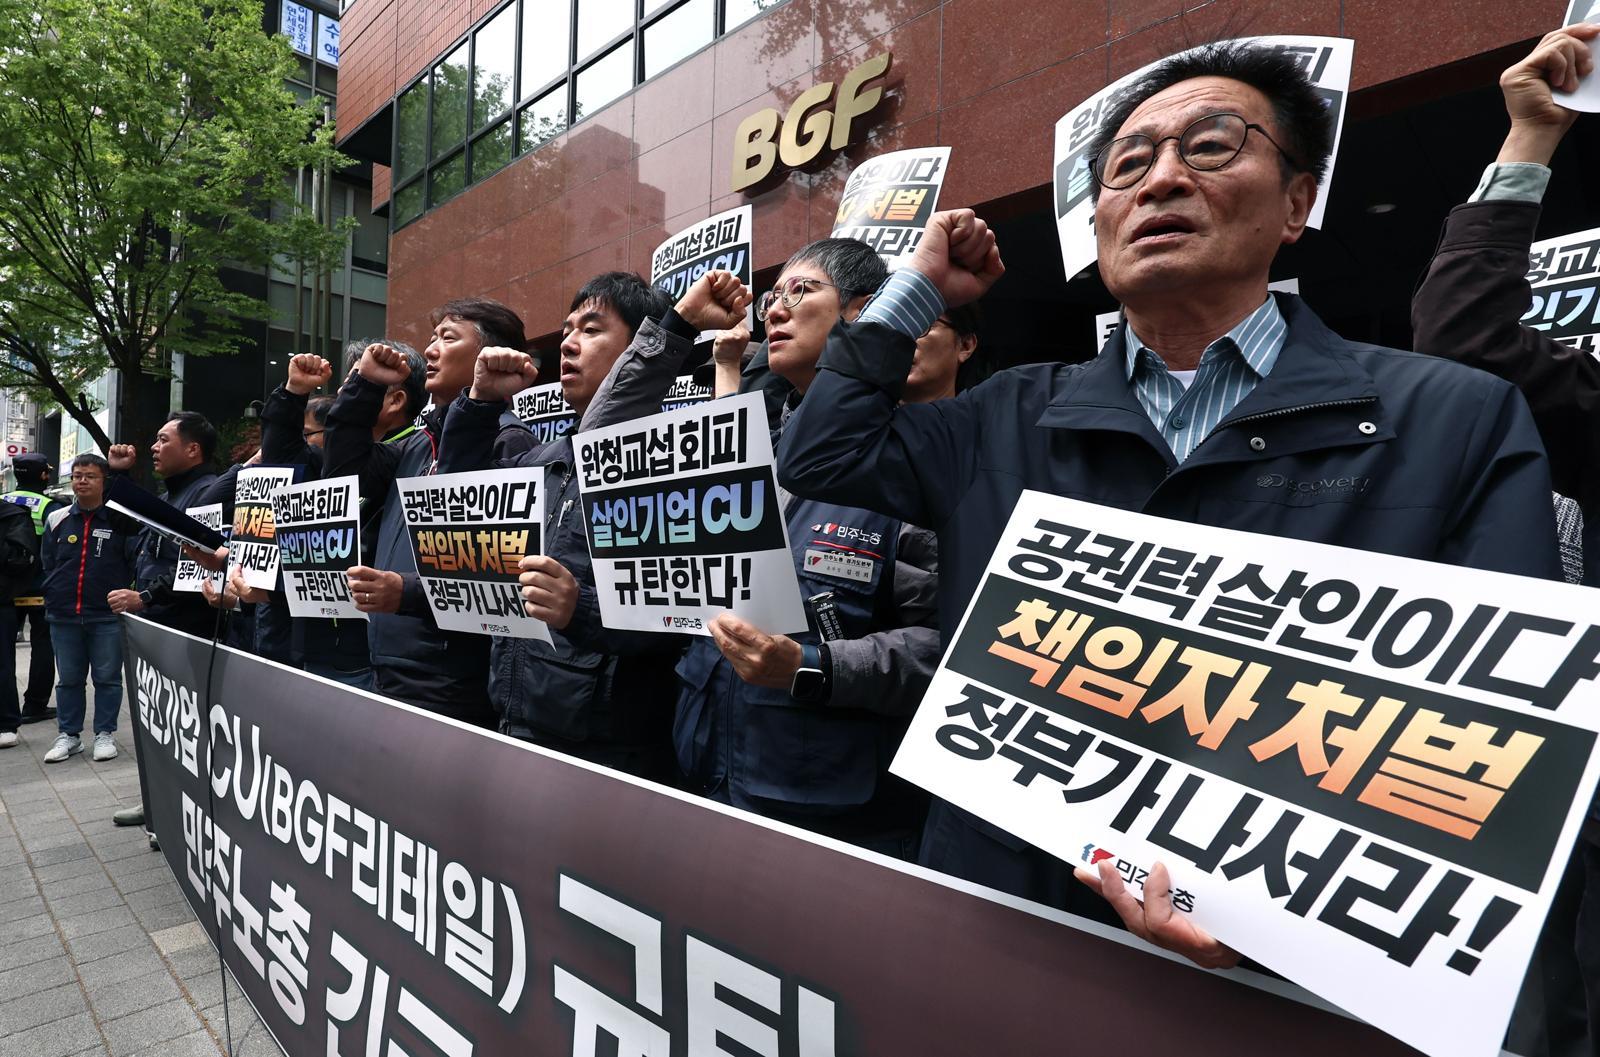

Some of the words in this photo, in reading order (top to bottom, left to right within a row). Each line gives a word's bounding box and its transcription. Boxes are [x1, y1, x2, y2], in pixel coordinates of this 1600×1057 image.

[324, 23, 339, 62] 수액
[731, 52, 893, 192] BGF
[703, 214, 743, 253] 회피
[517, 388, 563, 419] 원청교섭
[581, 424, 675, 488] 원청교섭
[679, 407, 748, 472] 회피
[316, 485, 350, 519] 회피
[403, 487, 447, 522] 공권력
[447, 481, 537, 521] 살인이다
[591, 488, 696, 548] 살인기업
[702, 479, 765, 534] CU
[279, 529, 324, 564] 살인기업
[326, 528, 354, 559] CU
[417, 530, 477, 573] 책임자
[477, 529, 529, 575] 처벌
[837, 526, 882, 545] 민주노총
[479, 583, 533, 618] 나서
[614, 555, 752, 609] 규탄한다!
[673, 616, 703, 629] 민주노총
[1007, 518, 1224, 620] 공권력
[1197, 562, 1600, 711] 살인이다
[136, 657, 201, 778] 살인기업
[987, 597, 1273, 752] 책임자
[1248, 678, 1547, 841] 처벌
[182, 790, 312, 1026] 민주노총
[1116, 858, 1196, 913] 민주총
